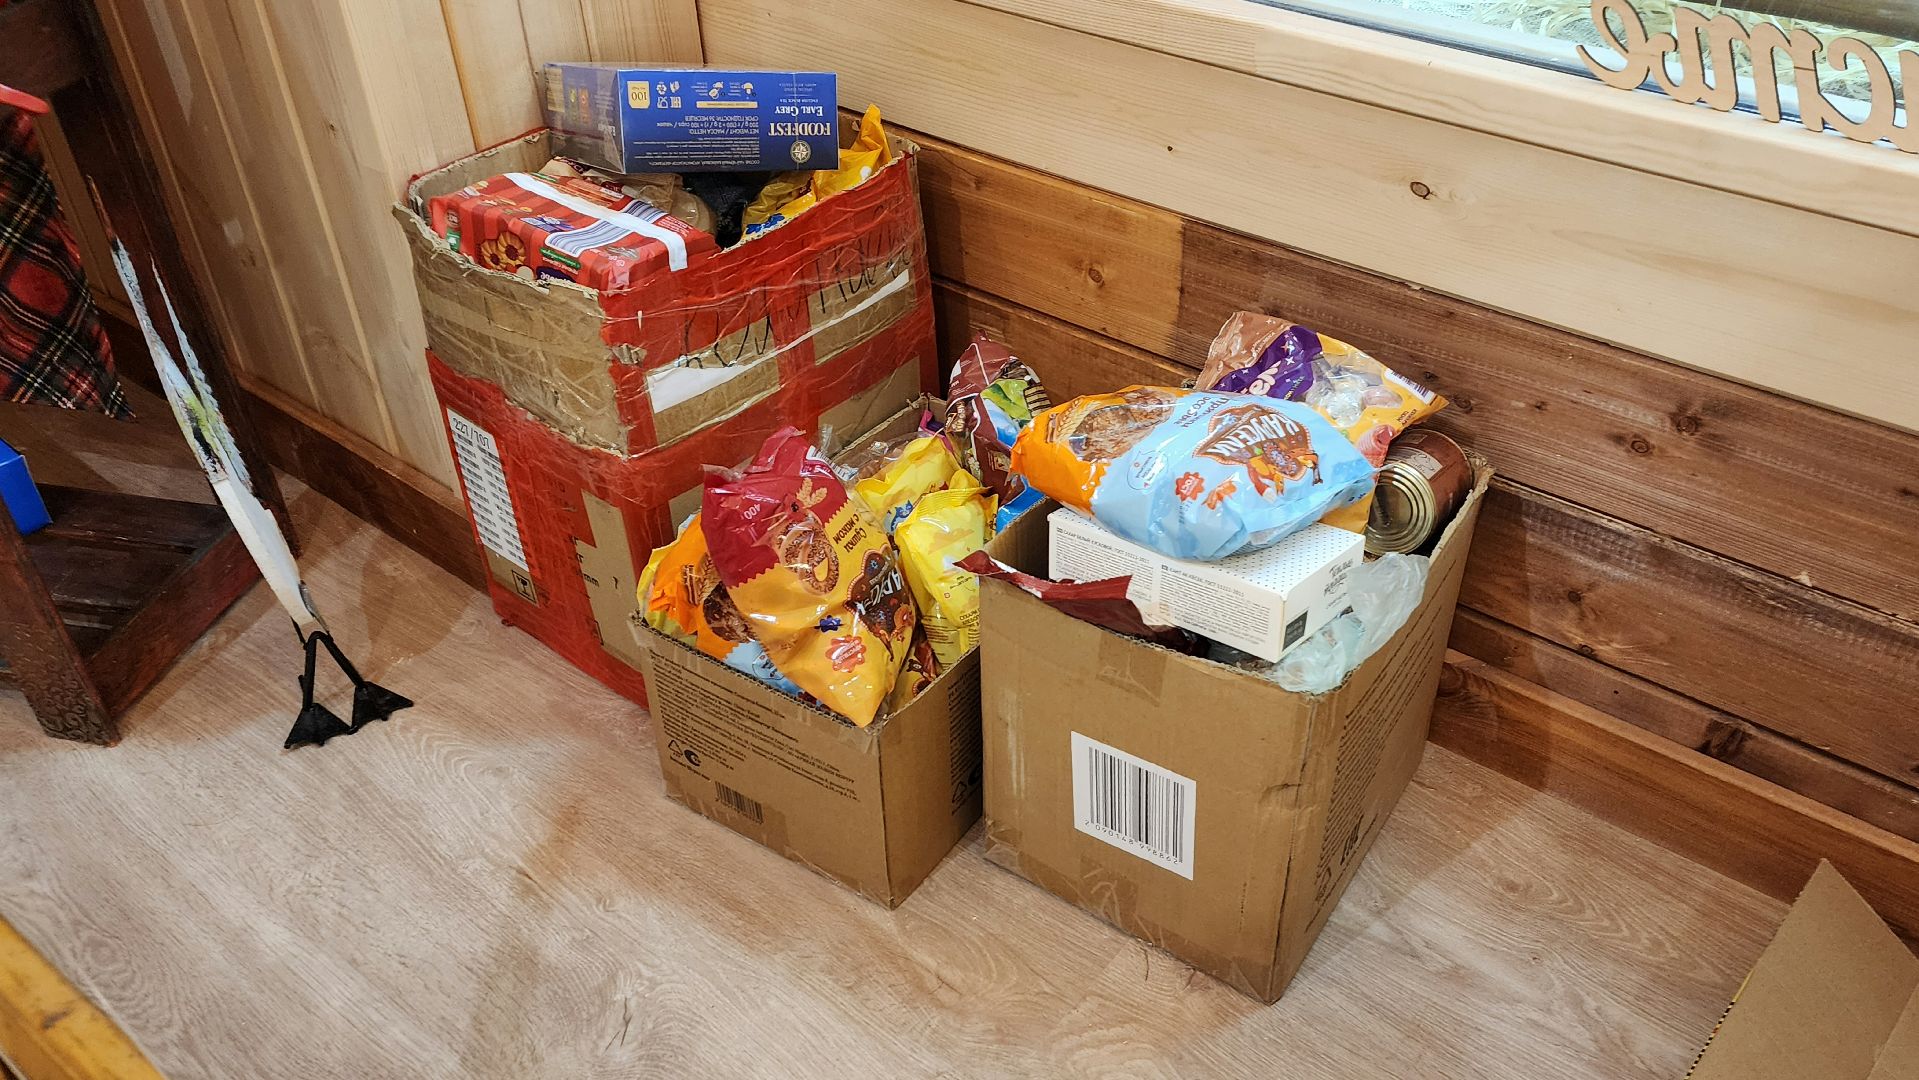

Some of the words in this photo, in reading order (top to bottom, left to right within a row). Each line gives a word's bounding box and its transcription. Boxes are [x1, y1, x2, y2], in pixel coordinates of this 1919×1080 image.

[631, 92, 647, 101] 100
[768, 122, 831, 136] FOODFEST
[1206, 412, 1300, 456] КАРУСЕЛИ
[743, 503, 761, 520] 400
[833, 519, 856, 545] маком
[844, 527, 867, 553] Сушки
